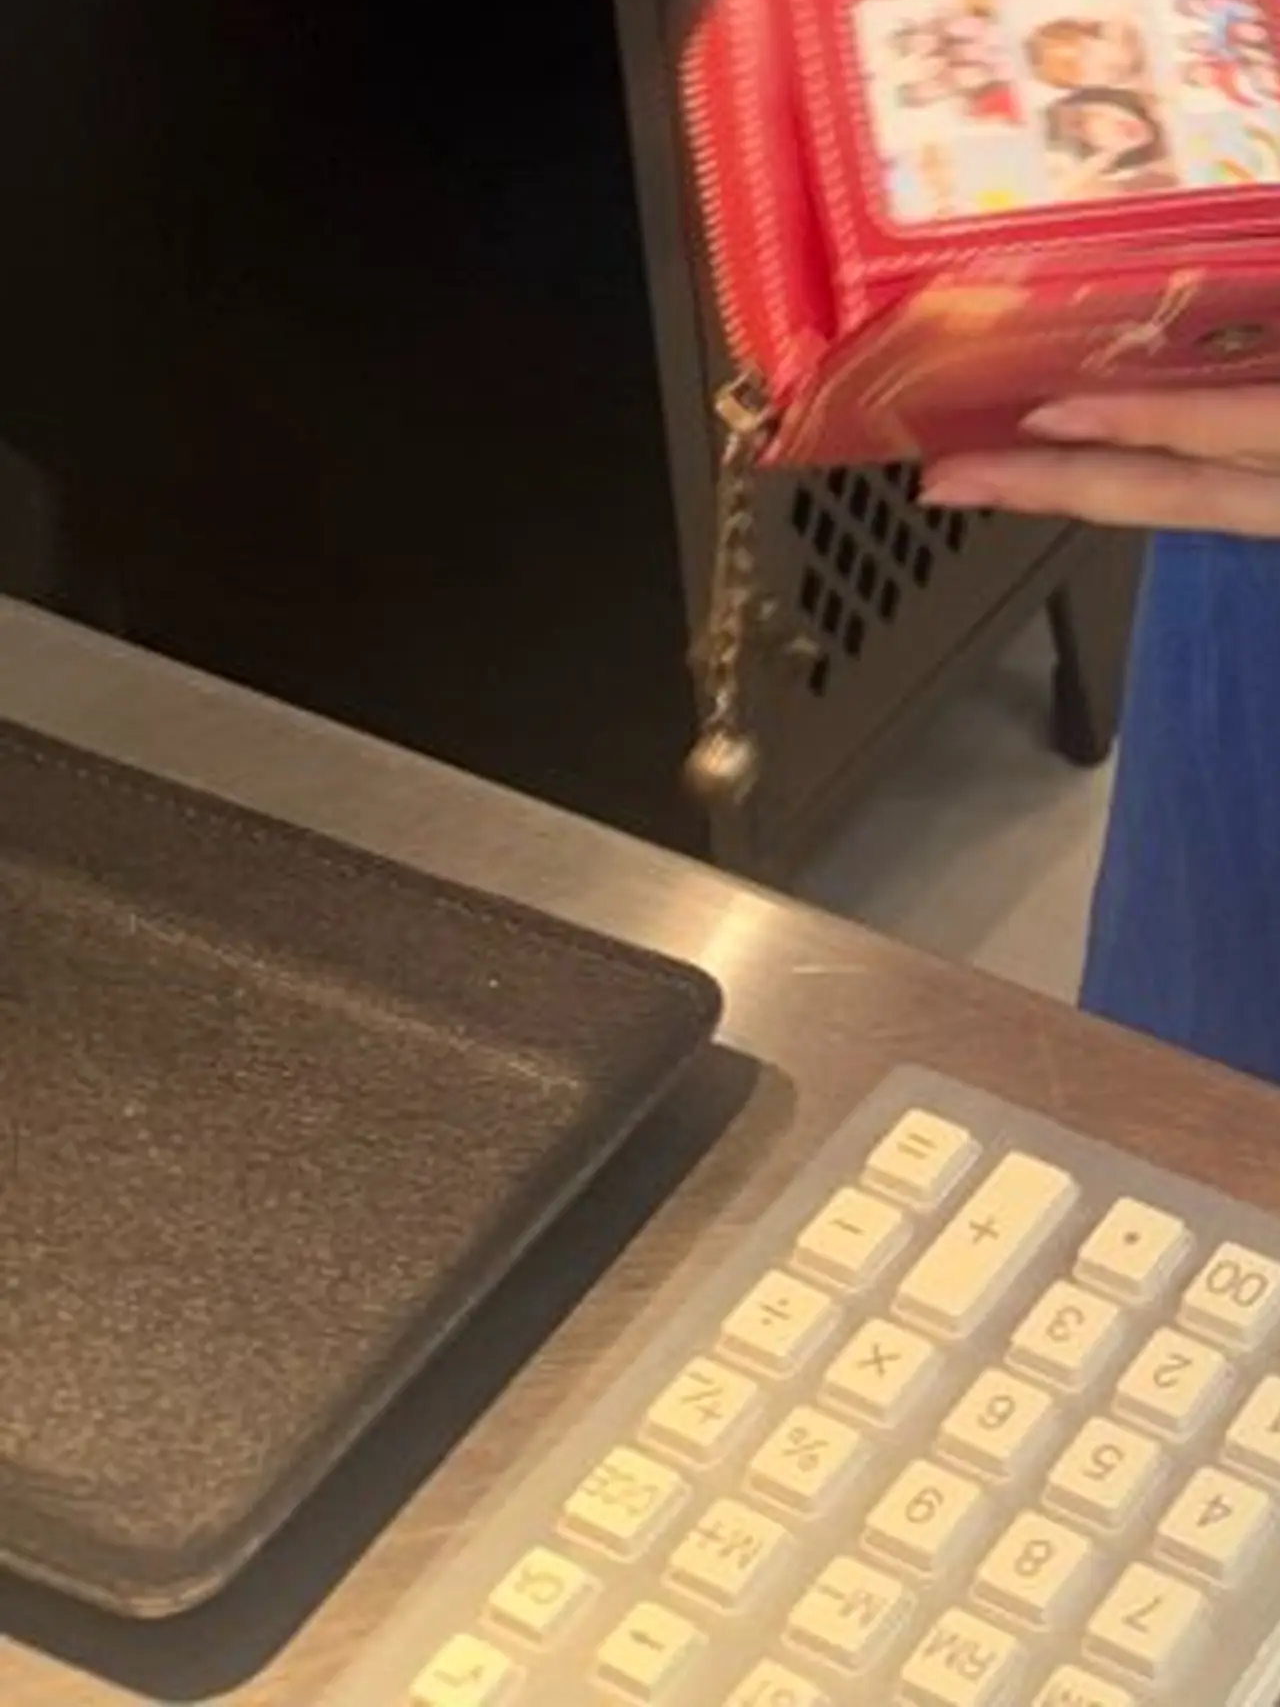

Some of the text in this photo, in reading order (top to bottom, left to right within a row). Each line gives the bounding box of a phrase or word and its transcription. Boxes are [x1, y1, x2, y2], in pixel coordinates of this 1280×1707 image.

[1205, 1259, 1269, 1308] 00
[1045, 1305, 1086, 1343] 3
[1153, 1353, 1193, 1390] 2
[977, 1395, 1016, 1430] 6
[782, 1426, 829, 1471] %
[1083, 1443, 1124, 1482] 5
[904, 1486, 944, 1525] 9
[1196, 1494, 1233, 1528] 4
[1014, 1538, 1053, 1578] 8
[1120, 1596, 1164, 1634] 7
[922, 1626, 996, 1681] RM
